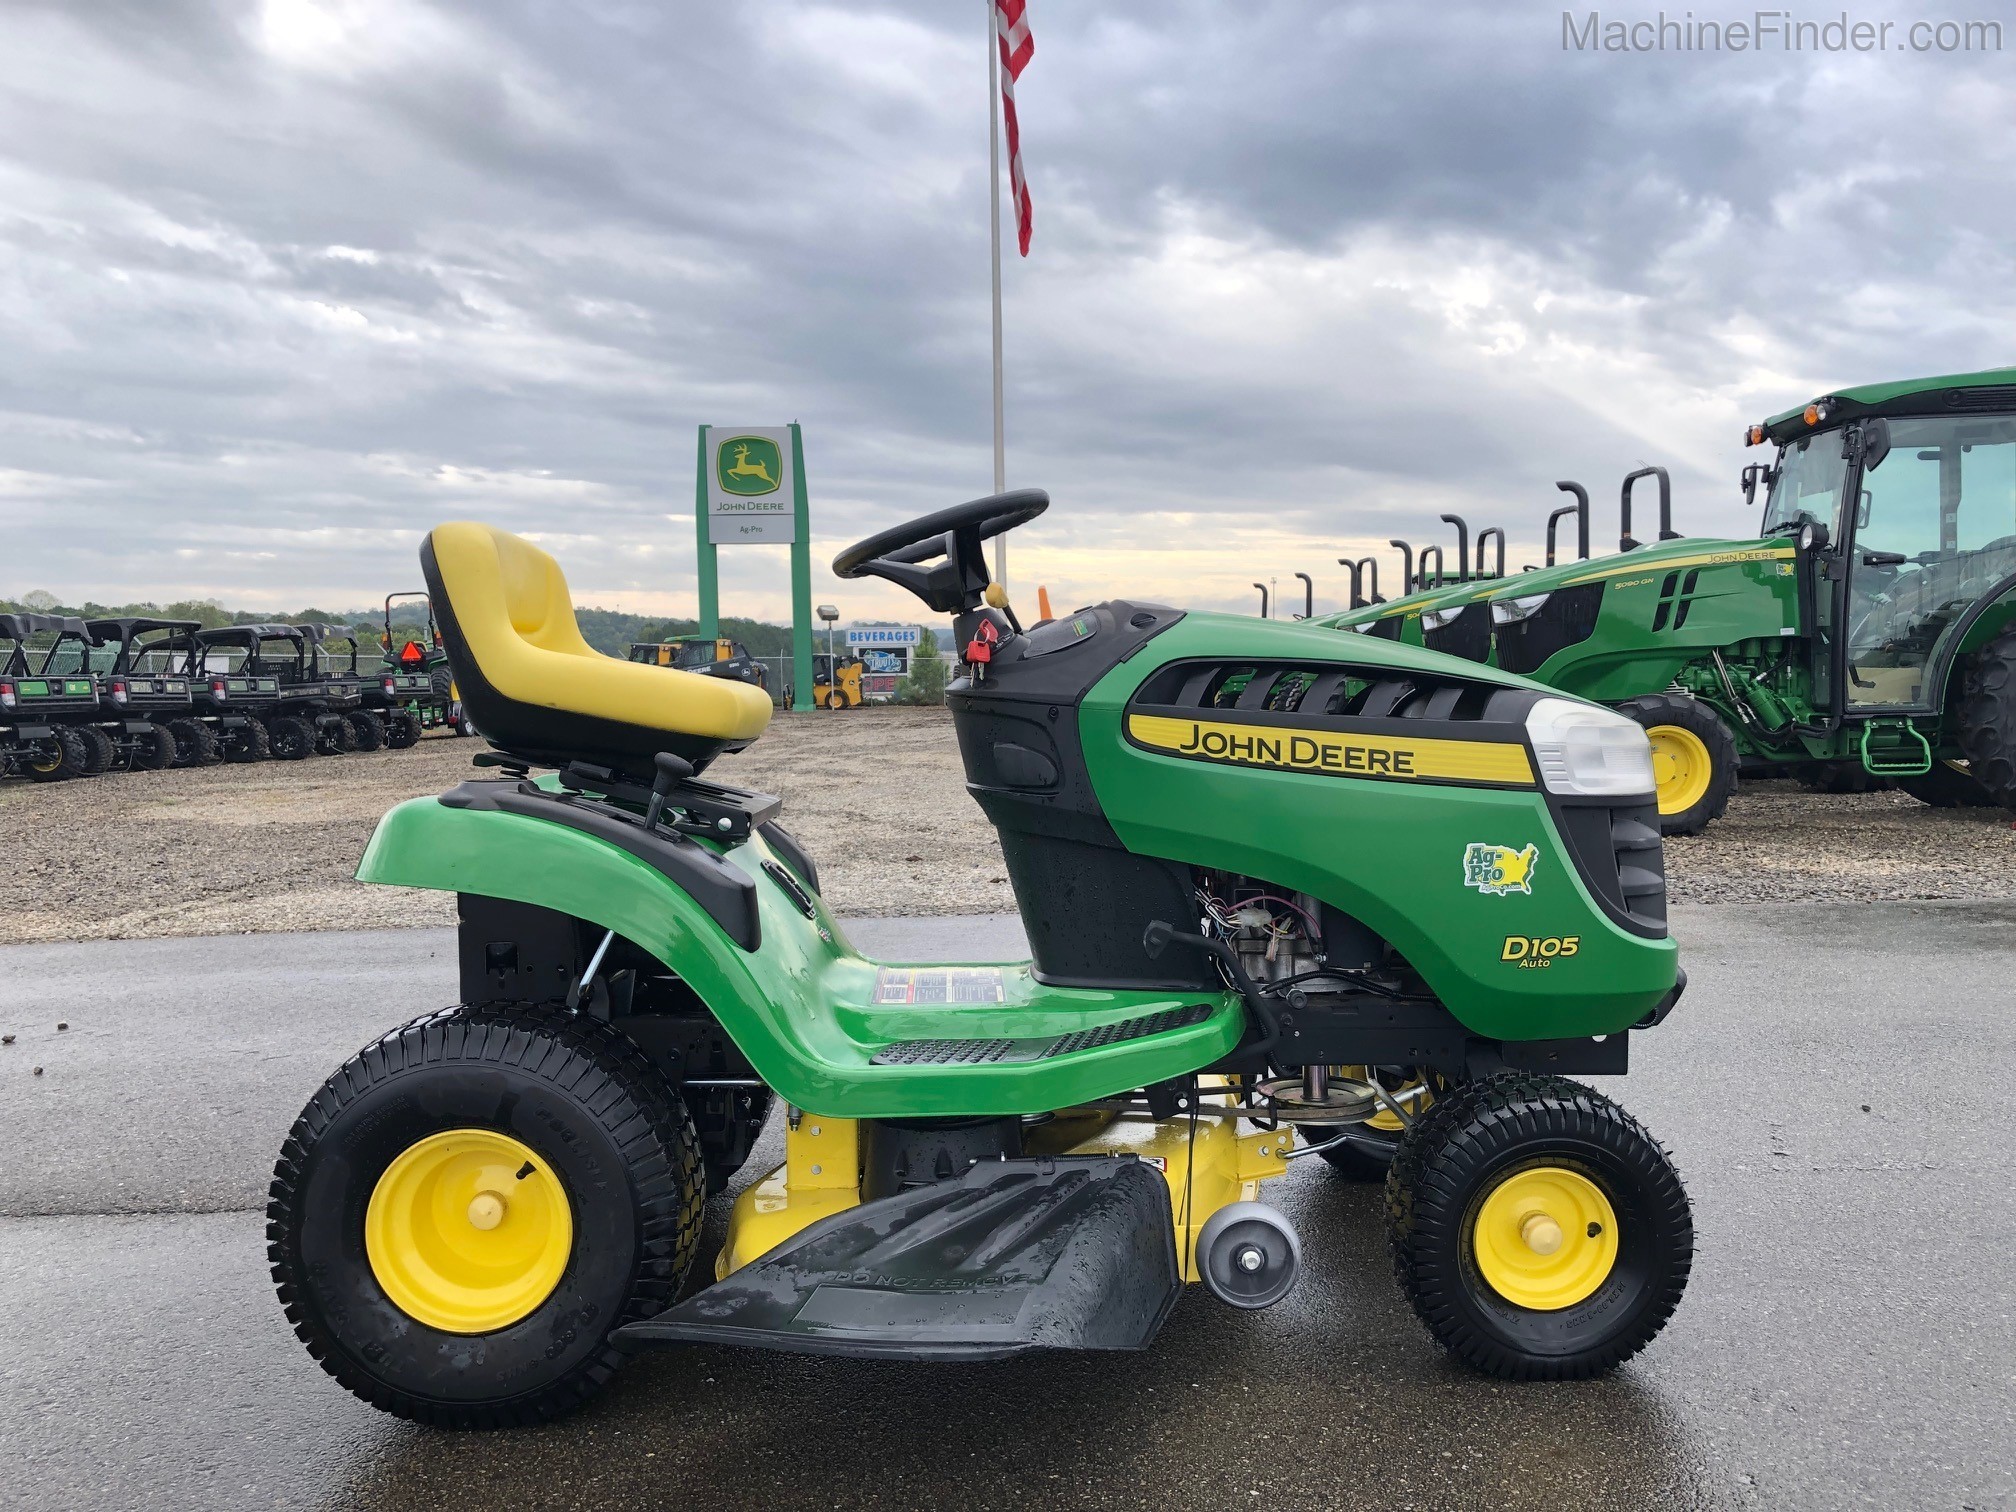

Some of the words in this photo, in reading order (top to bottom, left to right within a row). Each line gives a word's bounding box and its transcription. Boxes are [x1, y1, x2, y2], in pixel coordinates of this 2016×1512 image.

[717, 502, 746, 511] JOHN
[747, 501, 784, 511] DEERE
[740, 526, 763, 534] Ag-Pro
[1708, 554, 1737, 563] JOHN
[1739, 552, 1775, 561] DEERE
[850, 631, 915, 641] BEVERAGES
[1180, 724, 1281, 762] JOHN
[1290, 736, 1414, 774] DEERE
[1468, 847, 1503, 867] Ag-
[1468, 865, 1503, 882] Pro
[1501, 936, 1579, 960] D105
[1518, 958, 1550, 968] Auto
[835, 1272, 871, 1284] DO
[875, 1274, 925, 1288] NOT
[930, 1273, 1031, 1288] REMOVE
